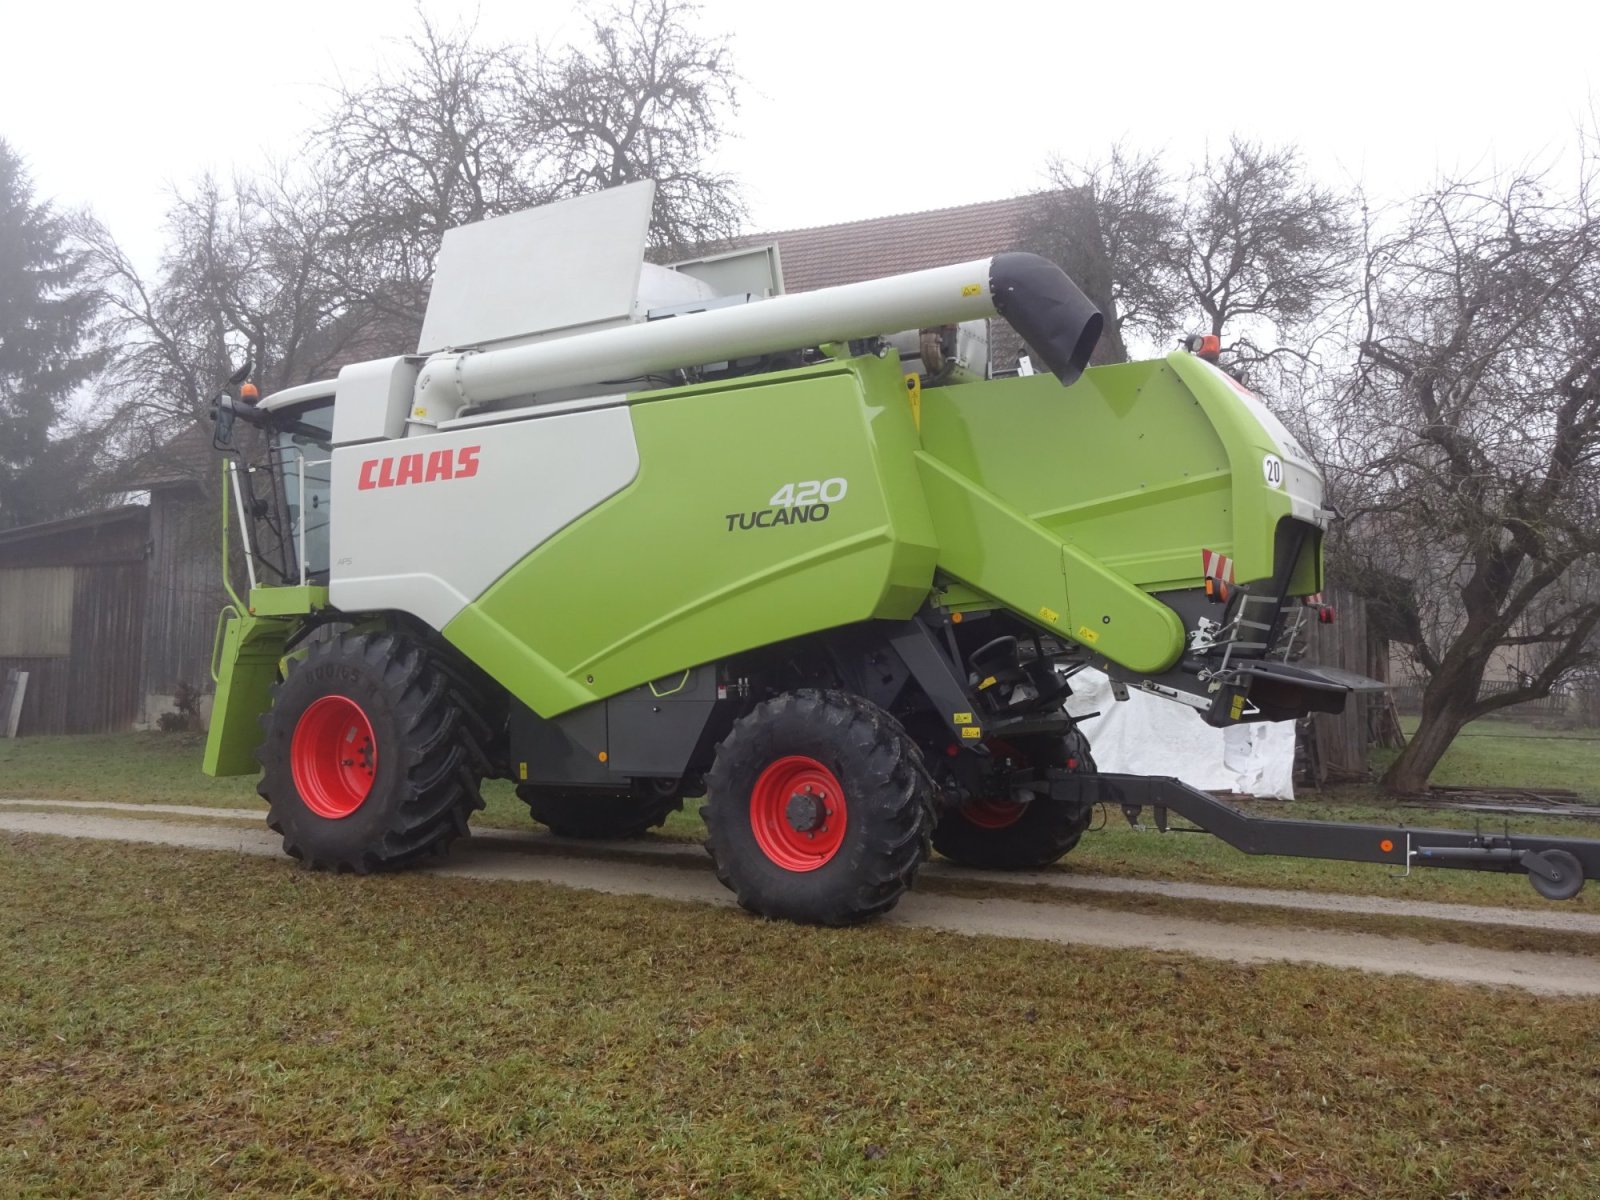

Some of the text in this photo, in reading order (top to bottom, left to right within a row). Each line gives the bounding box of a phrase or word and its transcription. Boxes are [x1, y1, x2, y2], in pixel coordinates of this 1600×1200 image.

[358, 445, 481, 490] CLAAS
[1266, 460, 1280, 483] 20
[769, 477, 848, 507] 420
[725, 503, 830, 532] TUCANO
